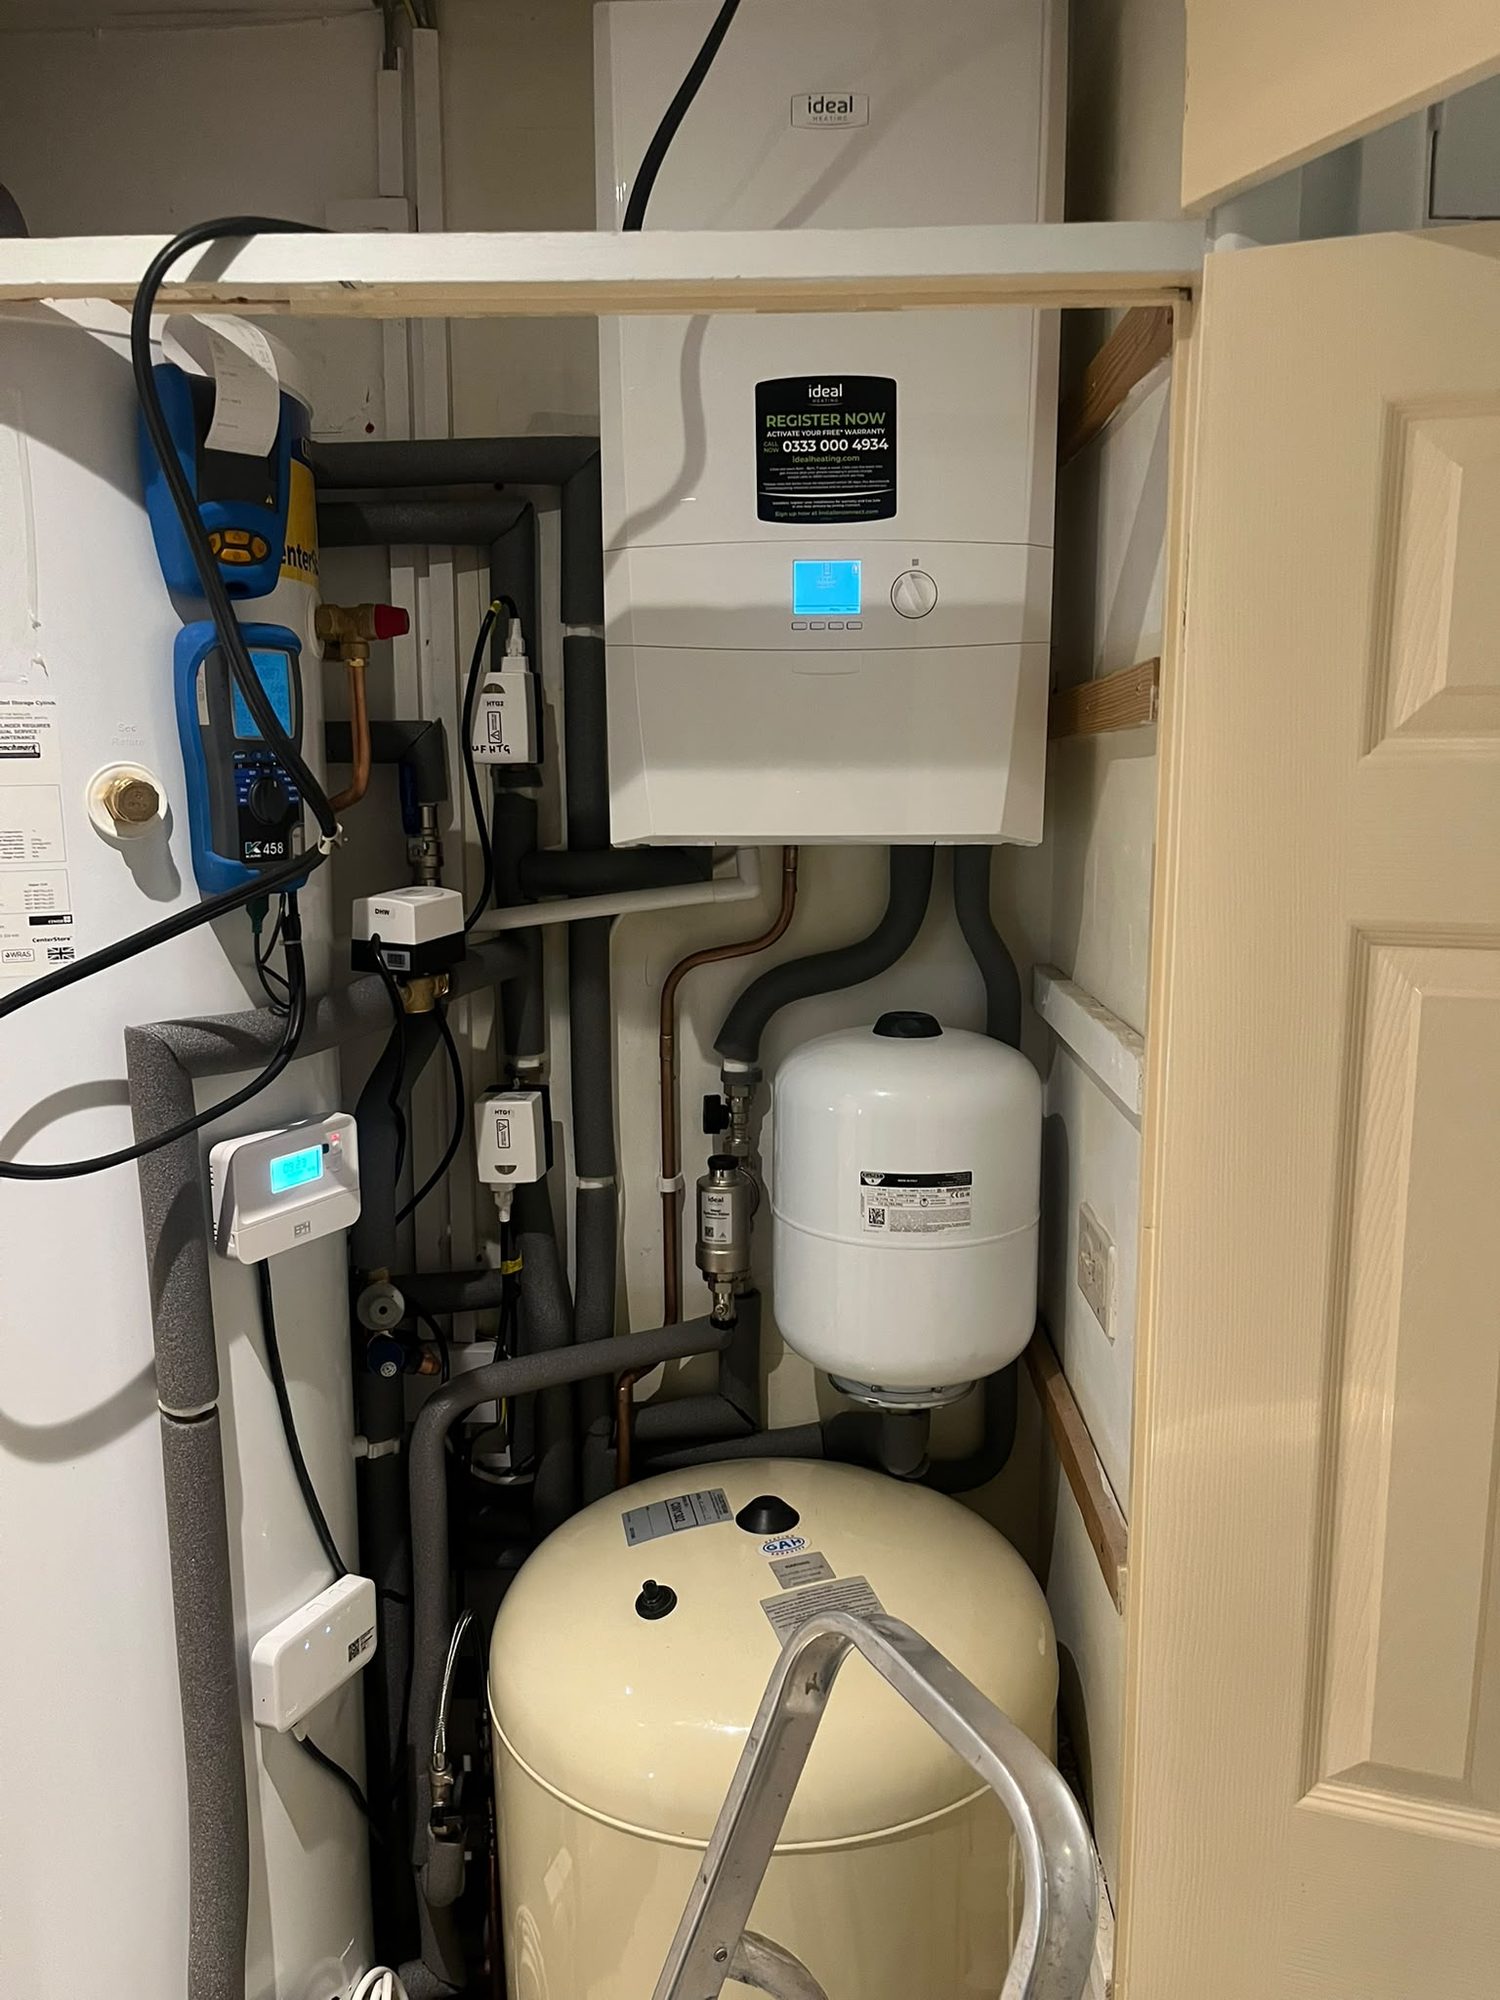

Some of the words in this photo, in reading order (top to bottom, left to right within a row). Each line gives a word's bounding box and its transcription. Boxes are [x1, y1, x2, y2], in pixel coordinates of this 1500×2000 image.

[808, 95, 853, 114] ideal
[808, 384, 843, 398] ideal
[766, 413, 840, 428] REGISTER
[845, 412, 886, 426] NOW
[767, 430, 800, 438] ACTIVATE
[801, 429, 821, 437] YOUR
[844, 428, 885, 436] WARRANTY
[783, 439, 816, 453] 0333
[820, 439, 848, 452] 000
[852, 438, 889, 451] 4934
[792, 454, 860, 464] idealheating.com
[263, 842, 284, 855] 458
[10, 950, 31, 958] WRAS
[294, 1221, 311, 1237] EPH
[766, 1539, 801, 1551] GAH
